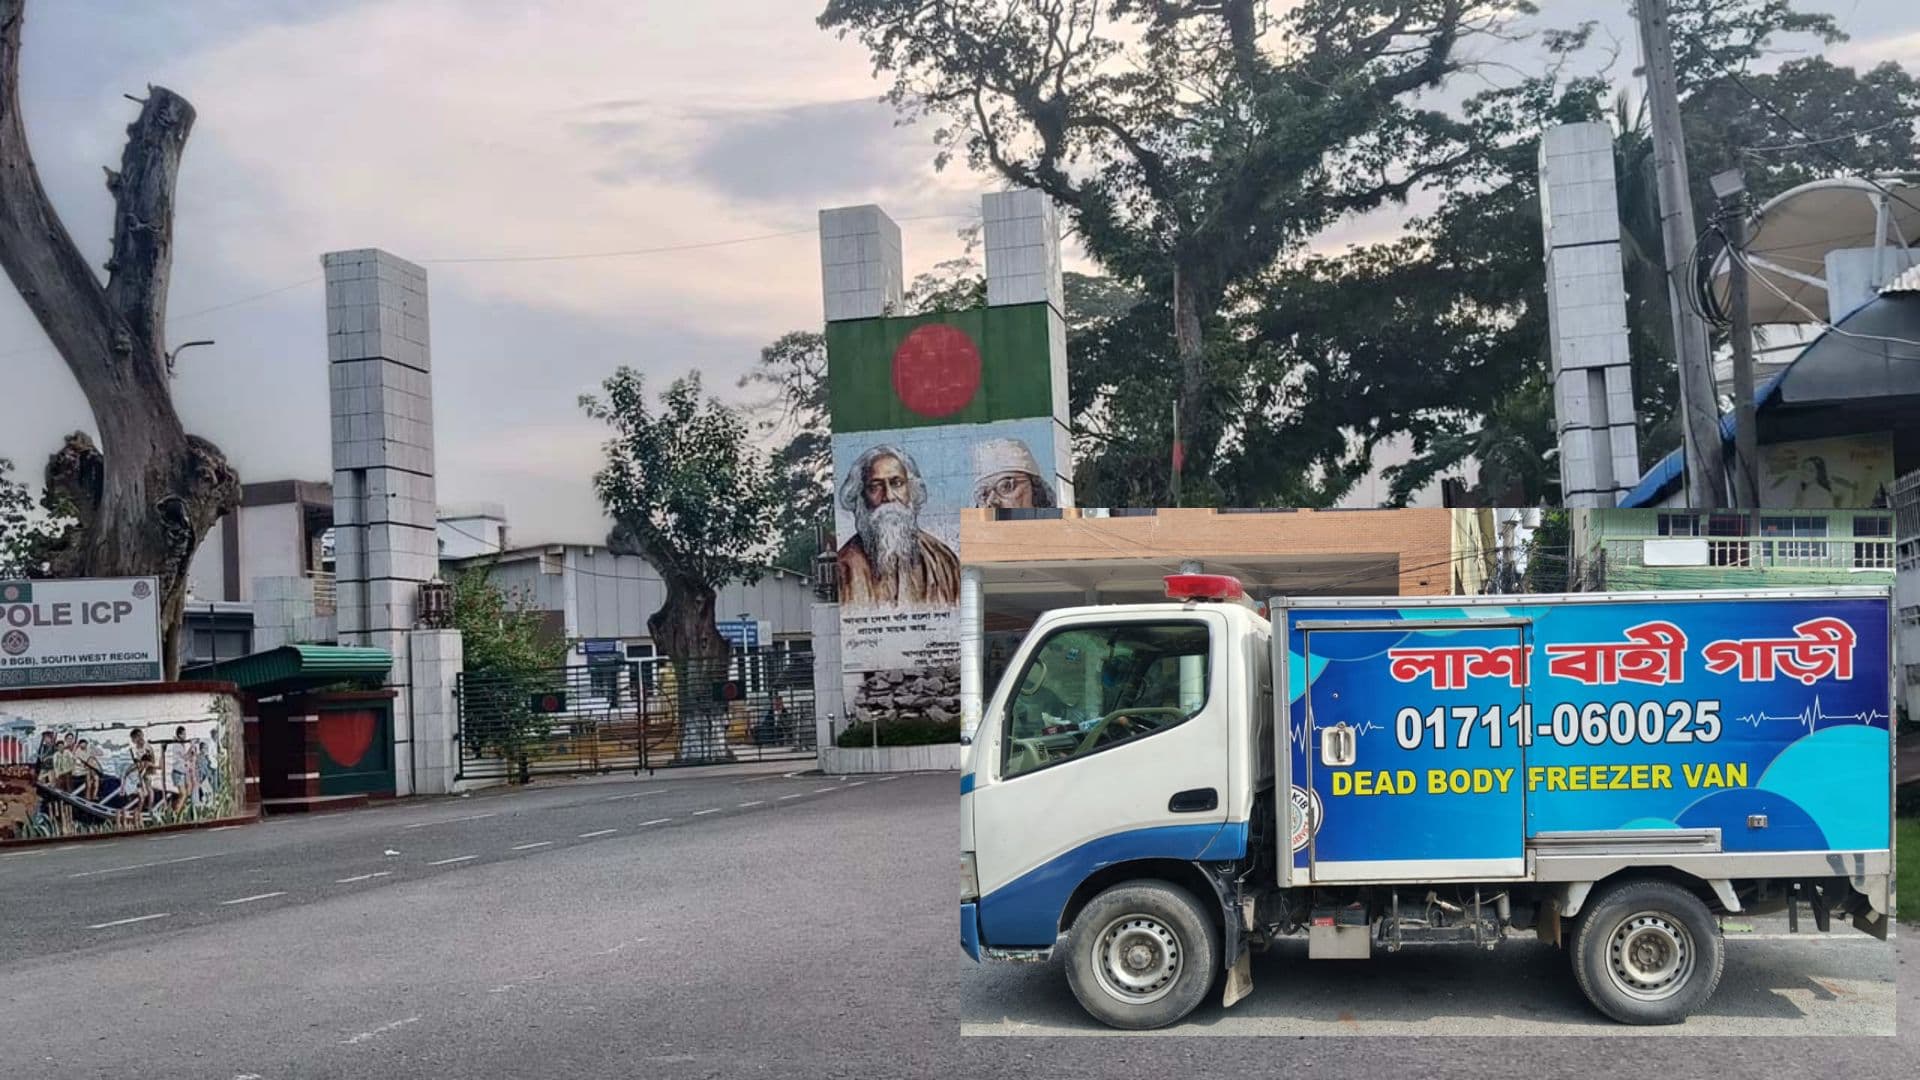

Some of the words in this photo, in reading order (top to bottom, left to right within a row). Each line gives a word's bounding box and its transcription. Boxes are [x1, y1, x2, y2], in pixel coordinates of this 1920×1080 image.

[82, 601, 133, 624] ICP
[41, 655, 77, 664] SOUTH
[79, 653, 108, 662] WEST
[110, 652, 149, 661] REGION
[1388, 644, 1532, 689] লাশ
[1545, 619, 1689, 688] বাহী
[1702, 617, 1857, 687] গাড়ী
[1395, 700, 1722, 749] 01711-060025
[1331, 770, 1417, 797] DEAD
[1427, 767, 1515, 795] BODY
[1528, 763, 1674, 792] FREEZER
[1681, 761, 1749, 789] VAN
